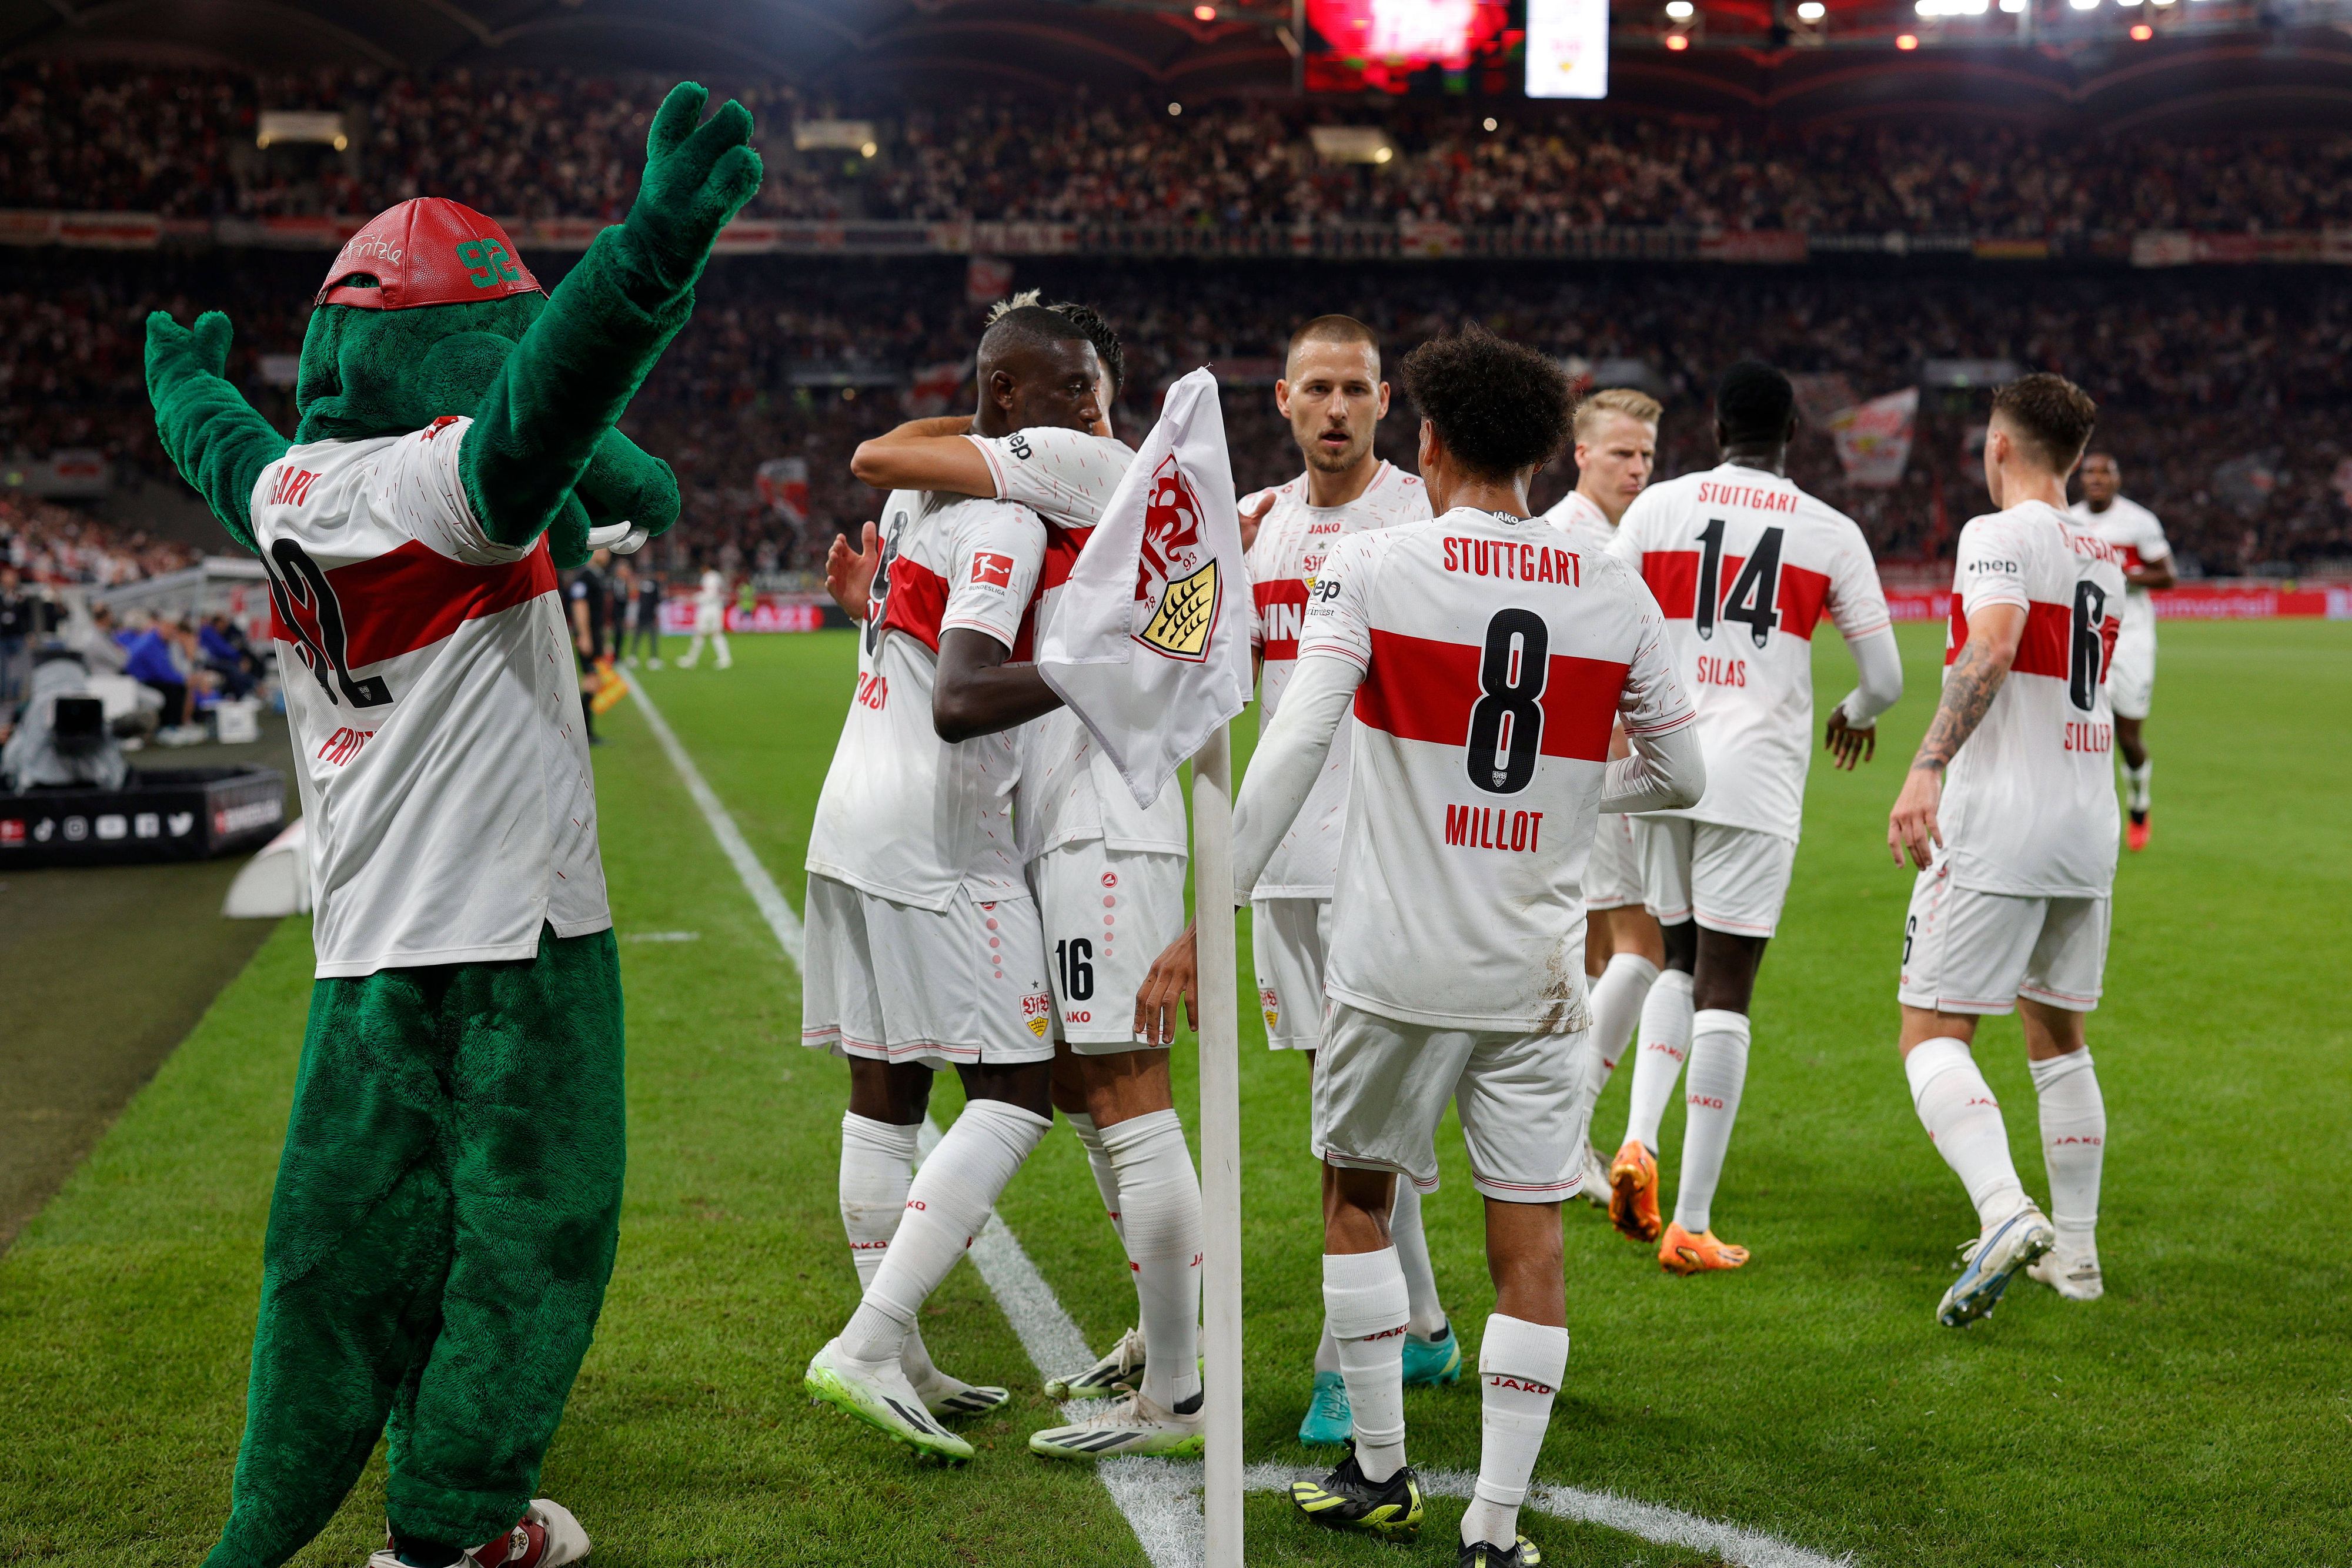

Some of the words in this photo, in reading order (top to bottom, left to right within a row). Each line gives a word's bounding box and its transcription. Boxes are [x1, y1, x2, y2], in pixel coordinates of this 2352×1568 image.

[345, 234, 403, 266] Fritzle
[456, 238, 521, 289] 92
[1698, 482, 1799, 514] STUTTGART
[1308, 523, 1341, 534] JAKO
[1494, 511, 1519, 524] JAKO
[1182, 551, 1198, 571] 93
[1443, 537, 1581, 588] STUTTGART
[1977, 560, 2017, 574] hep
[968, 584, 1005, 597] BUNDESLIGA
[1310, 580, 1341, 603] ep
[1696, 518, 1785, 649] 14
[2070, 580, 2106, 711] 6
[1698, 655, 1746, 687] SILAS
[1466, 607, 1549, 795] 8
[317, 727, 377, 767] FRIT
[1445, 804, 1544, 853] MILLOT
[1055, 938, 1094, 1002] 16
[1065, 1011, 1091, 1024] AKO
[849, 1241, 887, 1251] AKO
[1490, 1376, 1551, 1395] JAKO
